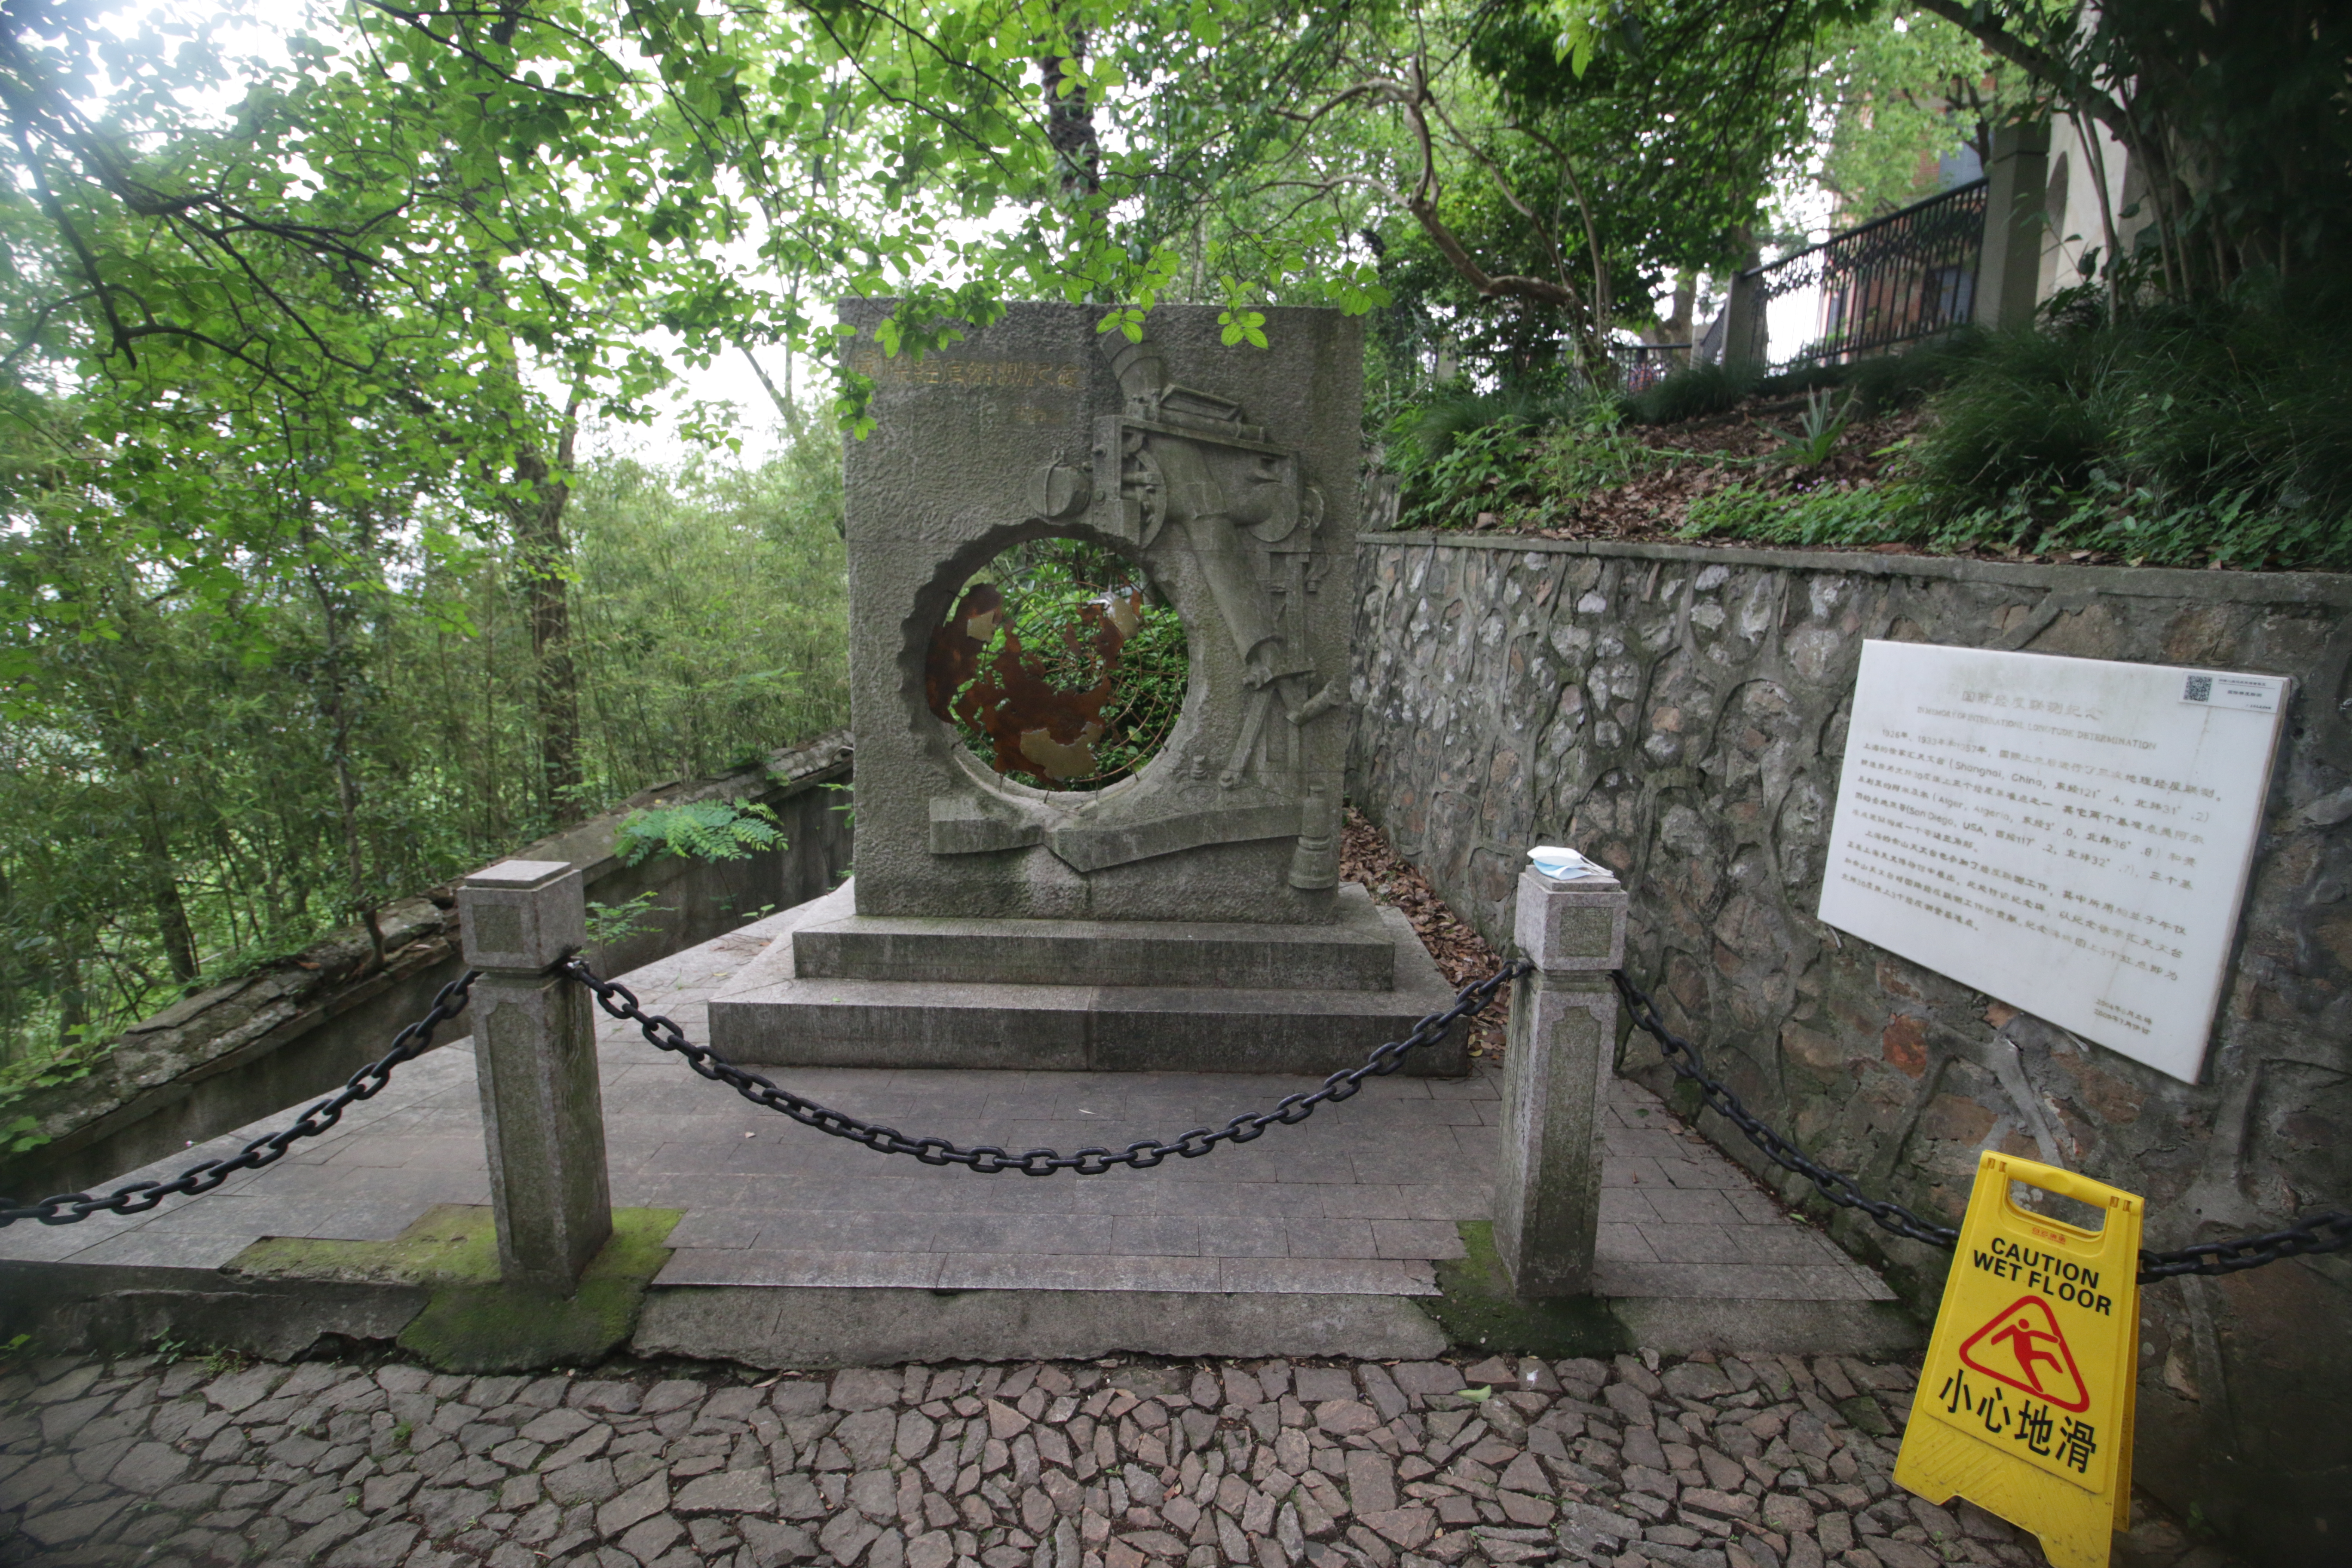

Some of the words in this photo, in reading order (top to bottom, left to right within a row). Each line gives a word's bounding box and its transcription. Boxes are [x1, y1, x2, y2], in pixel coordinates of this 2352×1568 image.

[1973, 1250, 2023, 1282] WET
[2028, 1272, 2113, 1316] FLOOR
[1991, 1237, 2099, 1289] CAUTION
[1939, 1369, 2097, 1474] 小心地滑
